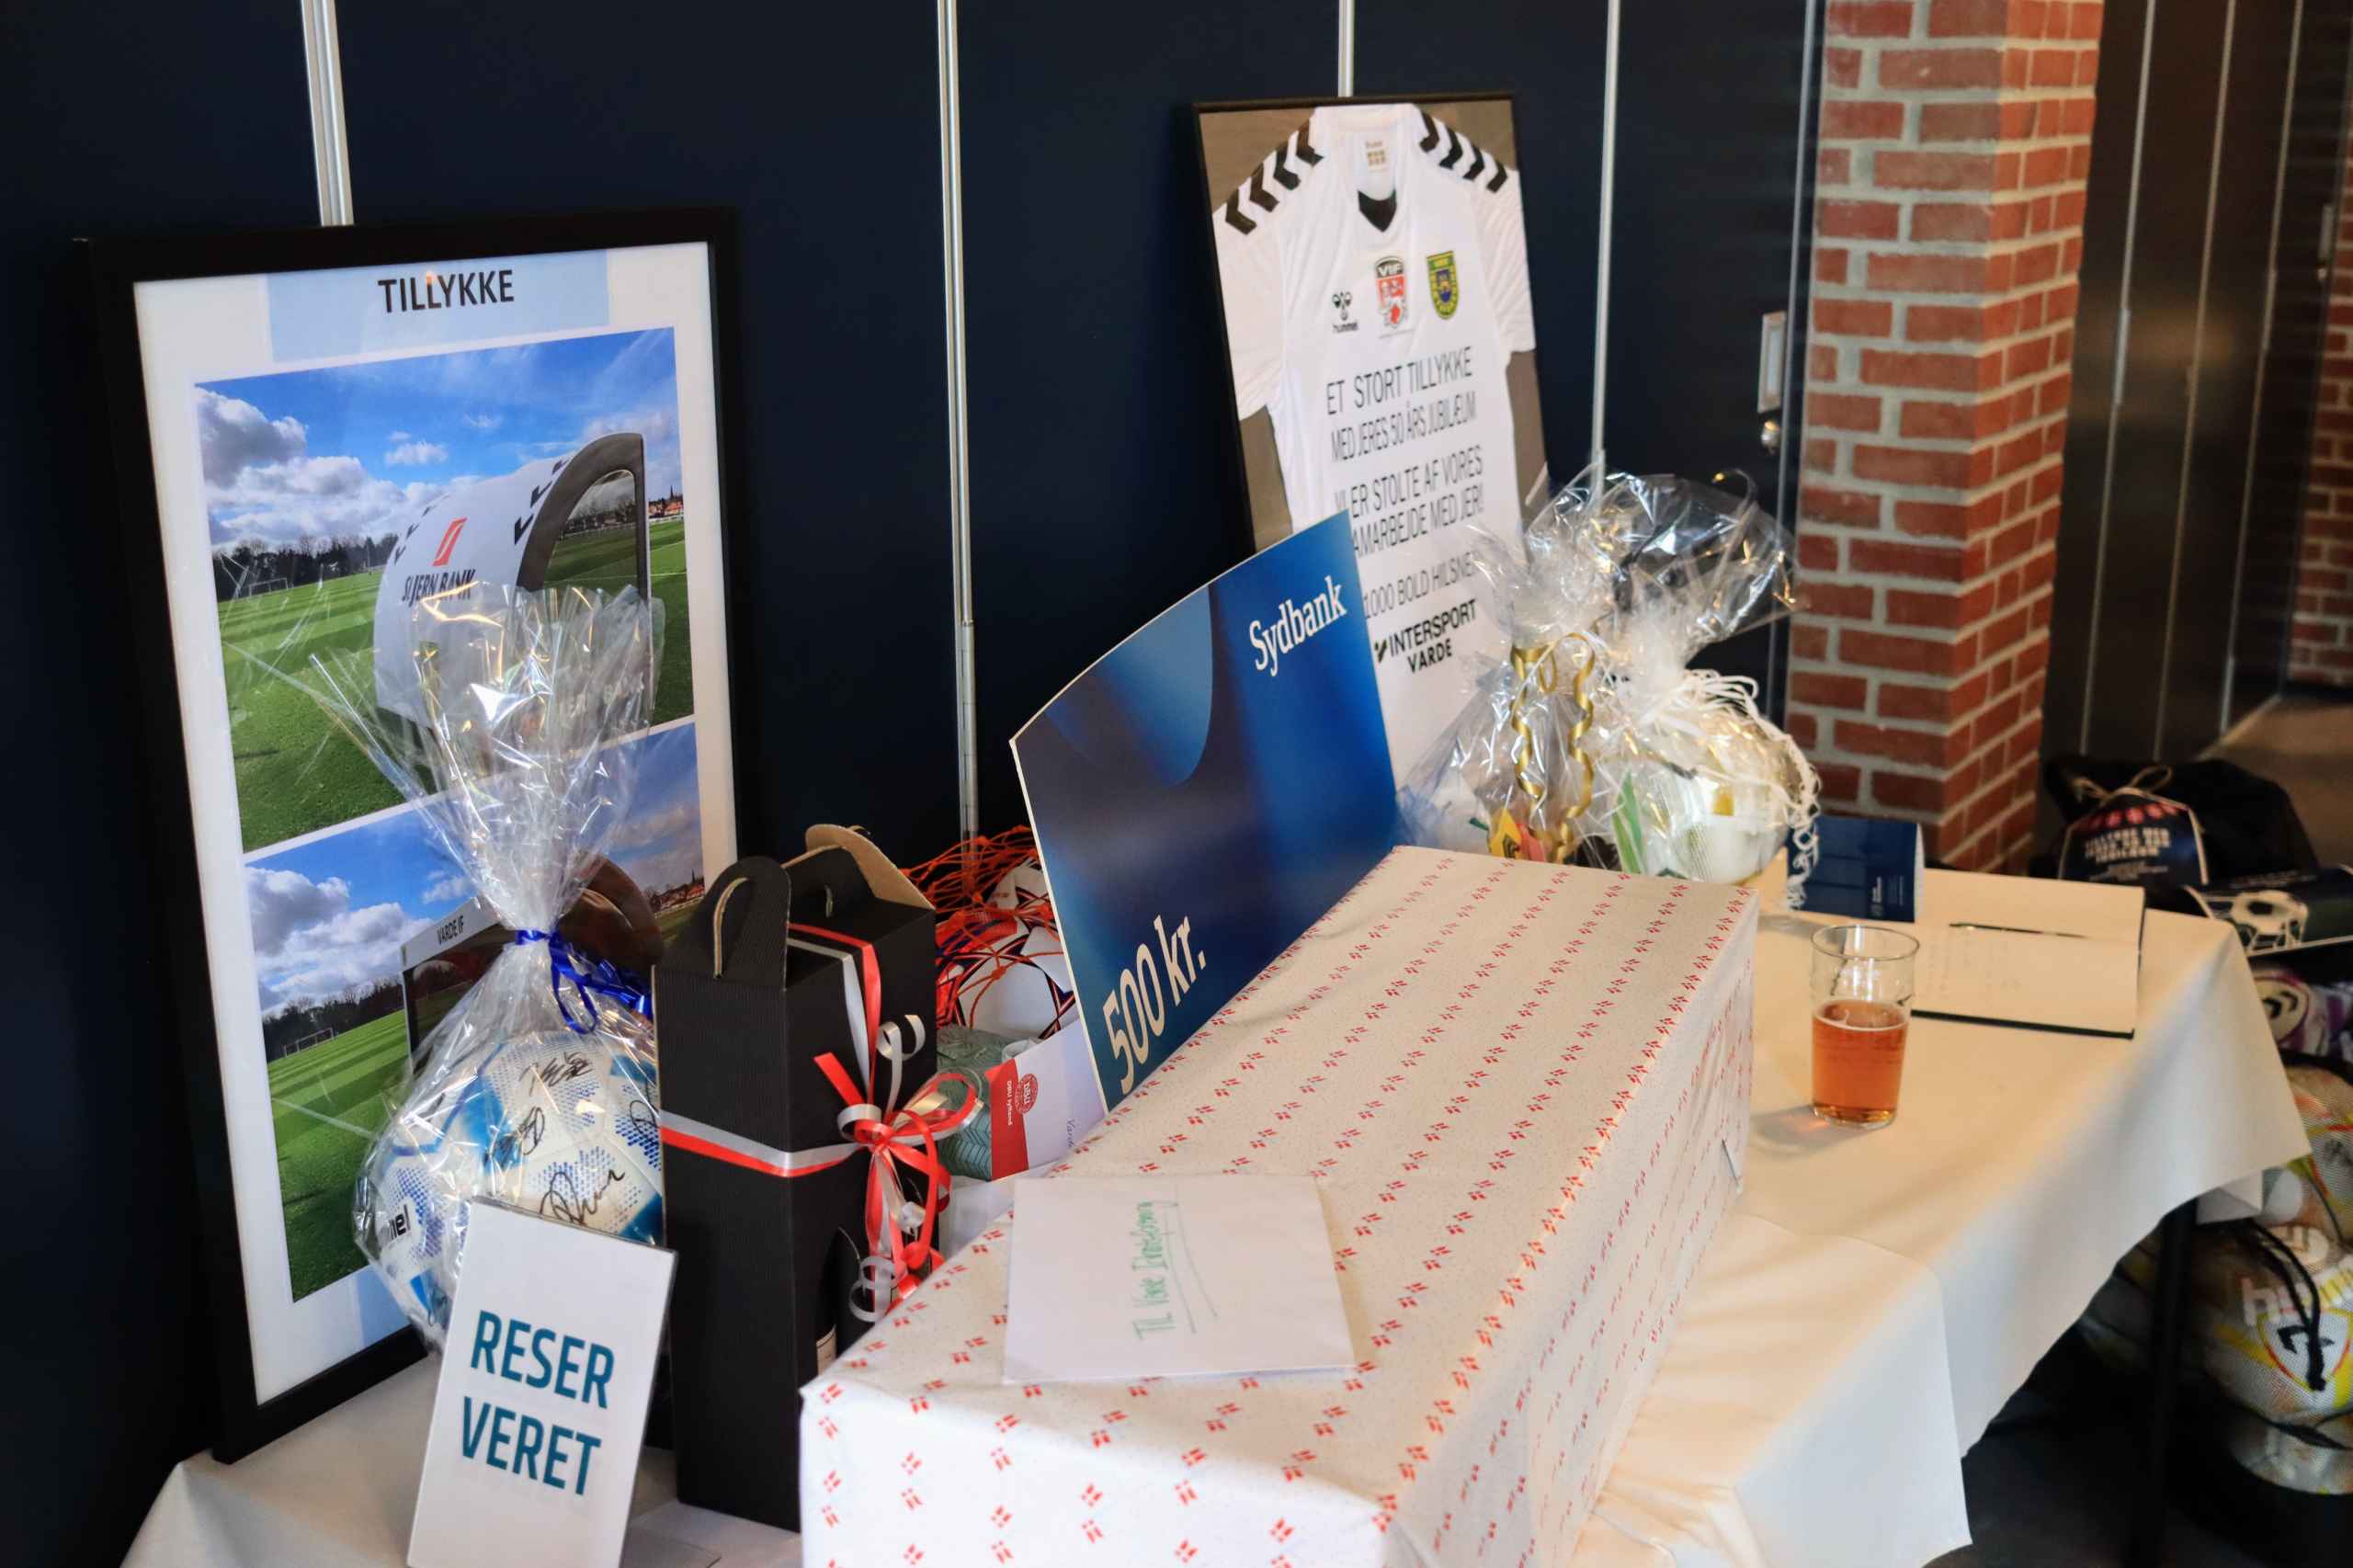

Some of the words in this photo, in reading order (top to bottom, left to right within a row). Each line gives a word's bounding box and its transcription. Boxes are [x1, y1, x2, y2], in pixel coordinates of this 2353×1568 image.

[378, 269, 515, 313] TILLYKKE
[1326, 380, 1345, 415] ET
[1354, 365, 1403, 408] STORT
[1407, 346, 1472, 393] TILLYKKE
[1332, 426, 1356, 460] MED
[1358, 416, 1390, 456] JERES
[1391, 412, 1404, 446] 50
[1406, 401, 1426, 441] ÅRS
[1351, 483, 1369, 518] ER
[1372, 465, 1421, 511] STOLTE
[1424, 459, 1439, 494] AF
[1441, 444, 1483, 486] VORES
[1353, 504, 1427, 558] AMARBEJDE
[1430, 493, 1458, 530] MED
[1397, 570, 1429, 606] BOLD
[1431, 551, 1475, 592] HILSNE
[1249, 574, 1347, 676] Sydbank
[1389, 599, 1476, 658] INTERSPORT
[1407, 638, 1452, 674] VARDE
[438, 919, 458, 945] VARDE
[1103, 943, 1165, 1096] 500
[1154, 915, 1207, 1006] kr.
[471, 1310, 615, 1409] RESER
[462, 1396, 602, 1496] VERET
